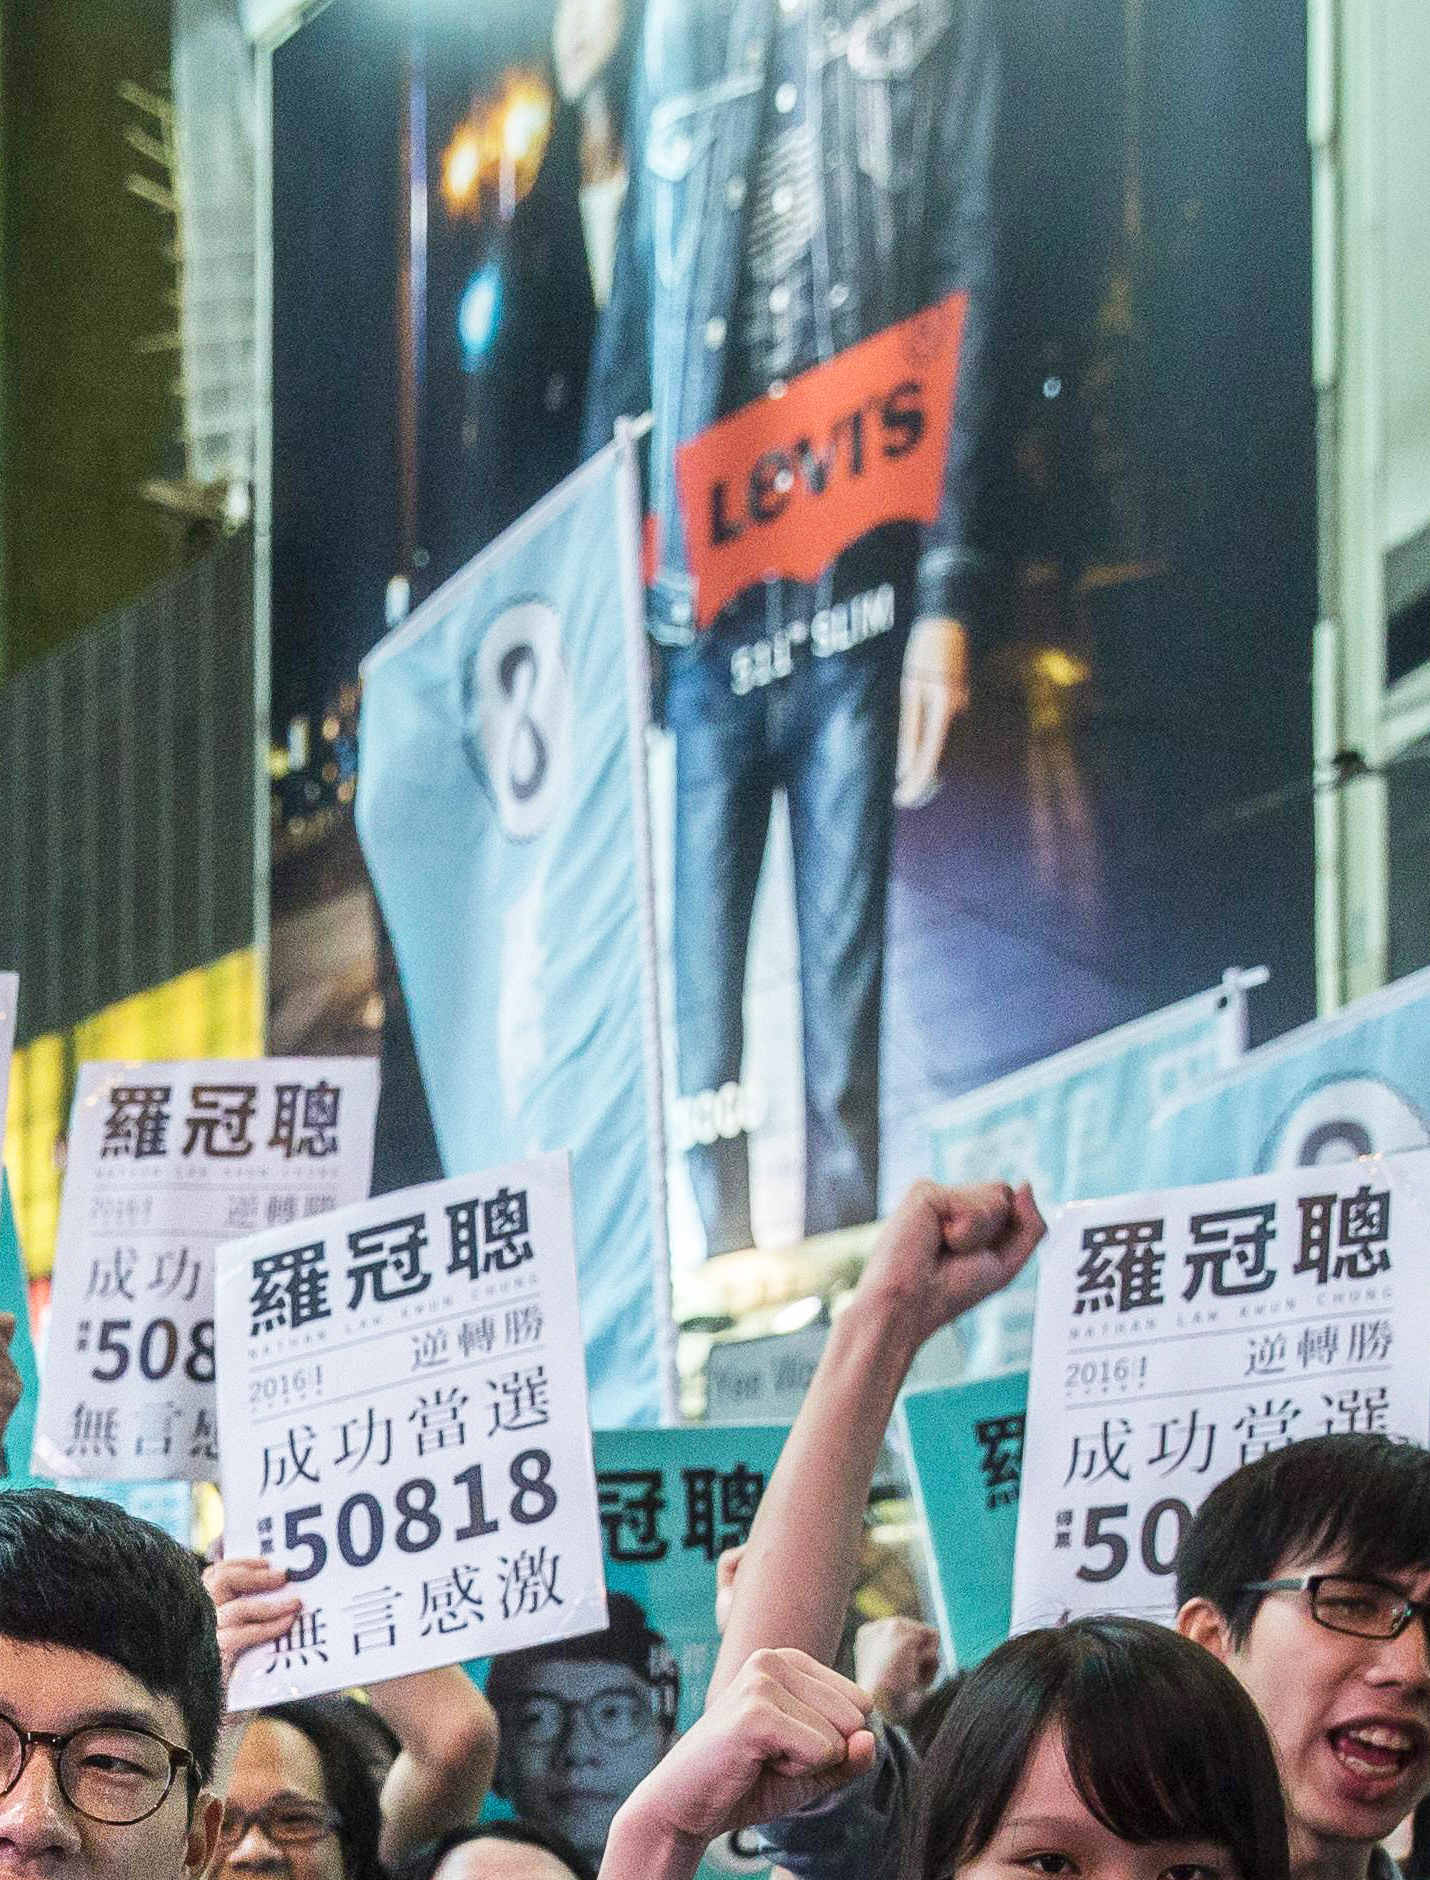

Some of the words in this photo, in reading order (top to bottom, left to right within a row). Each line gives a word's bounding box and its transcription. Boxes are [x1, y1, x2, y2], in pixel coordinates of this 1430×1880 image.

[498, 640, 551, 802] 8
[100, 1081, 344, 1160] 羅冠聰
[248, 1186, 536, 1337] 羅冠聰
[1072, 1184, 1393, 1316] 羅冠聰
[411, 1303, 544, 1372] 逆轉勝
[1065, 1355, 1130, 1388] 2016
[1244, 1320, 1394, 1377] 逆轉勝
[259, 1364, 552, 1498] 成功當選
[284, 1447, 559, 1583] 50818
[265, 1544, 565, 1675] 無言感激
